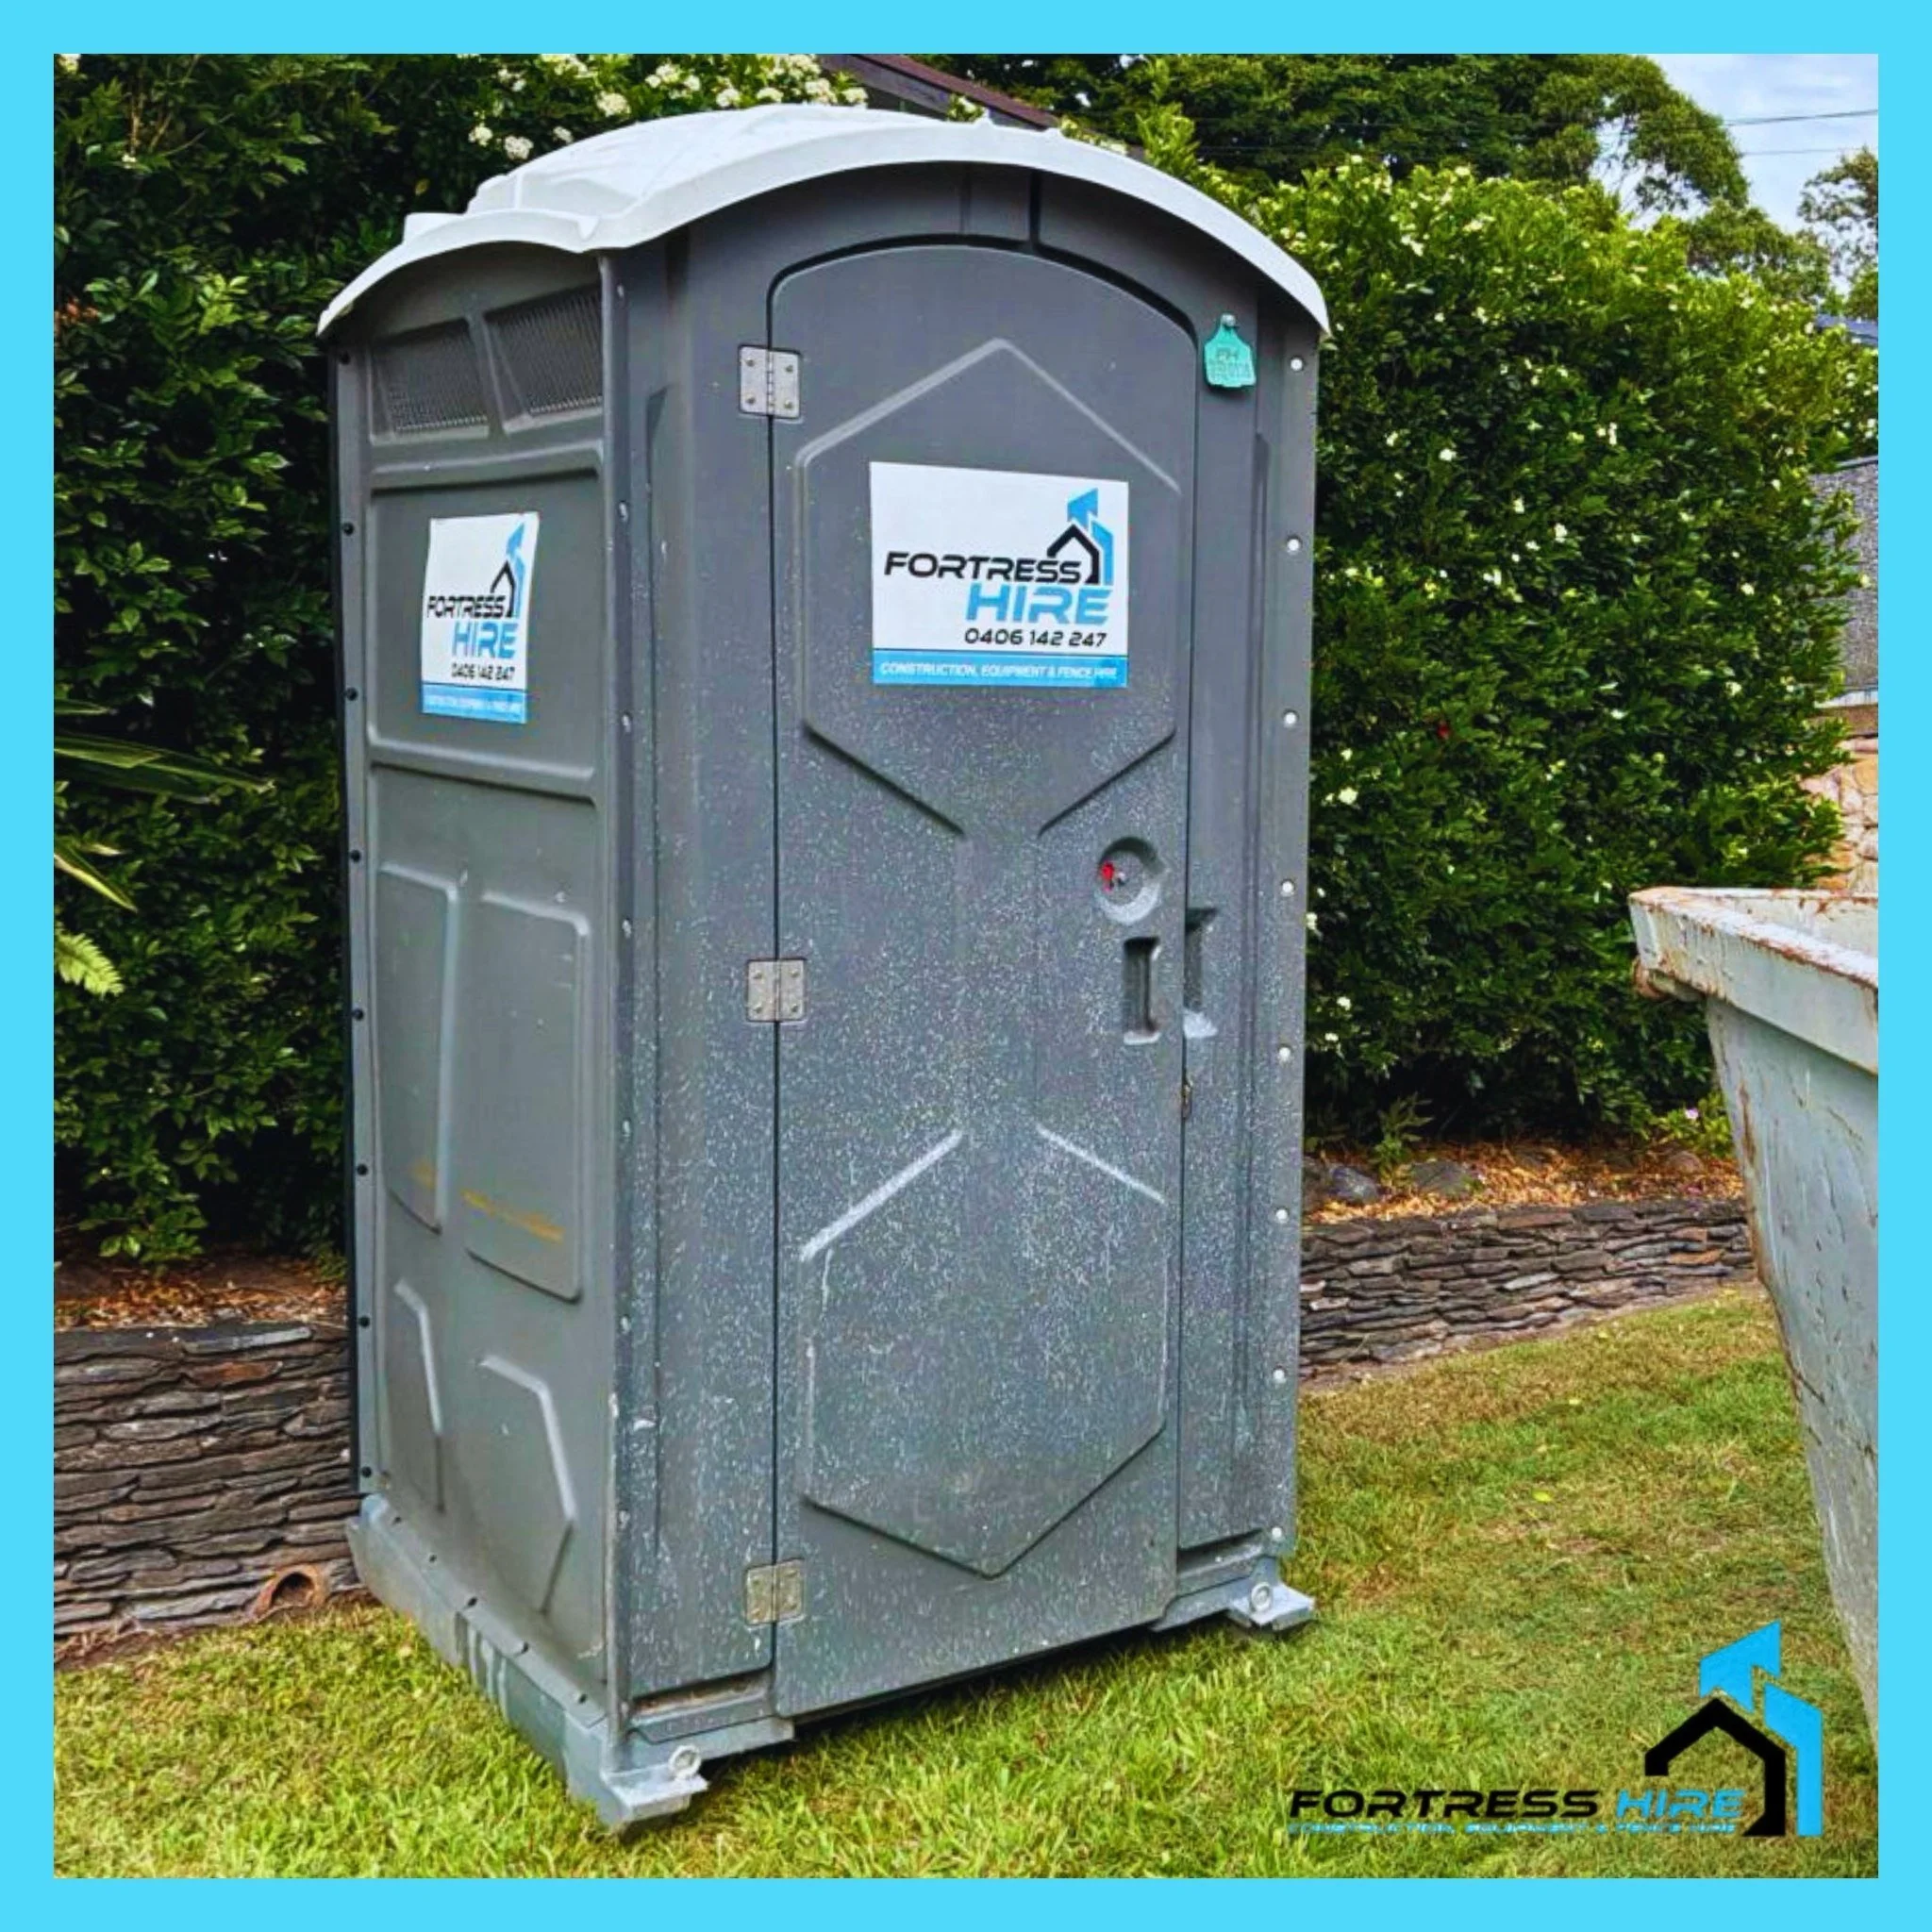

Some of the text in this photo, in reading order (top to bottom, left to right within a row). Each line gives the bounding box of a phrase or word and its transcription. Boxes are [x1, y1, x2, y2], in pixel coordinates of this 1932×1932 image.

[884, 551, 1082, 585] FORTRESS
[426, 594, 506, 620] FORTRESS
[965, 582, 1113, 626] HIRE
[452, 621, 519, 659] HIRE
[964, 627, 1107, 648] 0406 142 247
